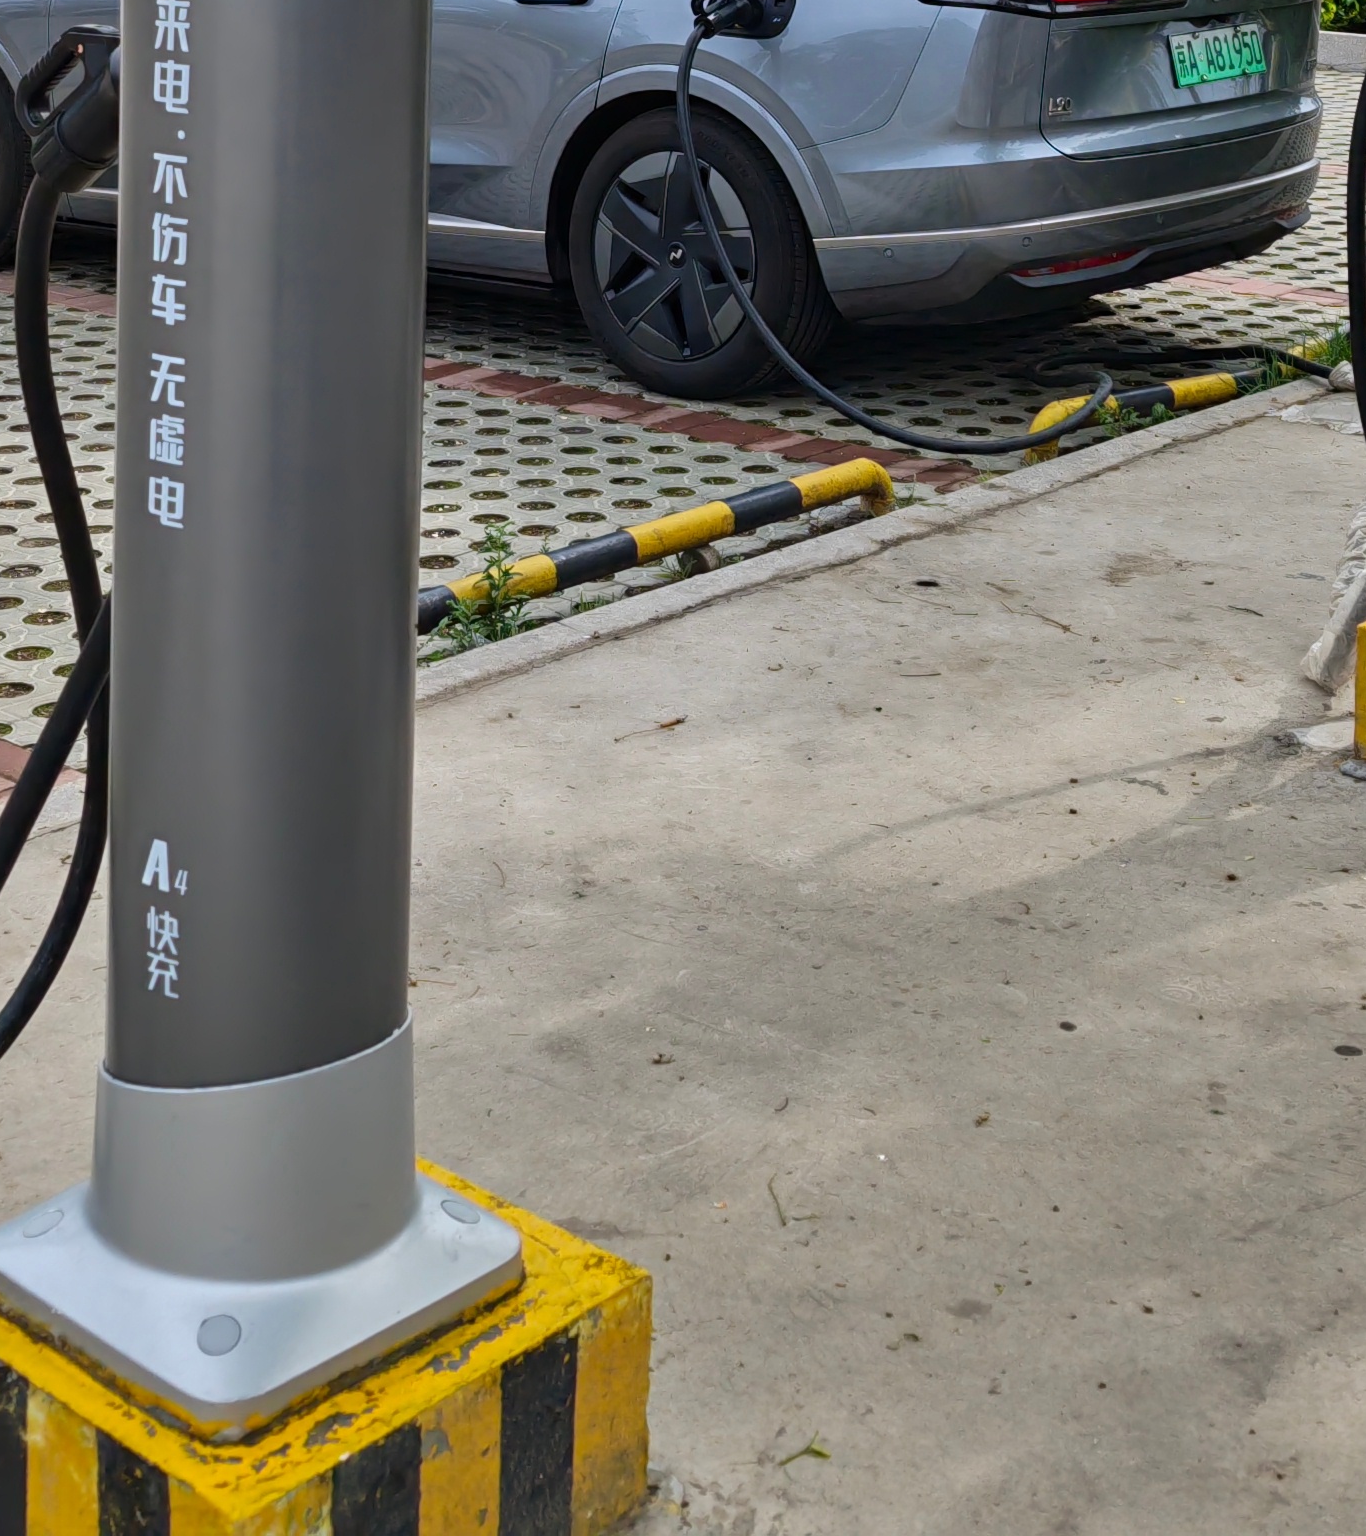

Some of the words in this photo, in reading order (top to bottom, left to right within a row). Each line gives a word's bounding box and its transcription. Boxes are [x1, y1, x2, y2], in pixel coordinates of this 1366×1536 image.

[1048, 97, 1073, 112] L90
[148, 353, 186, 529] 无虚电
[146, 905, 180, 999] 快充
